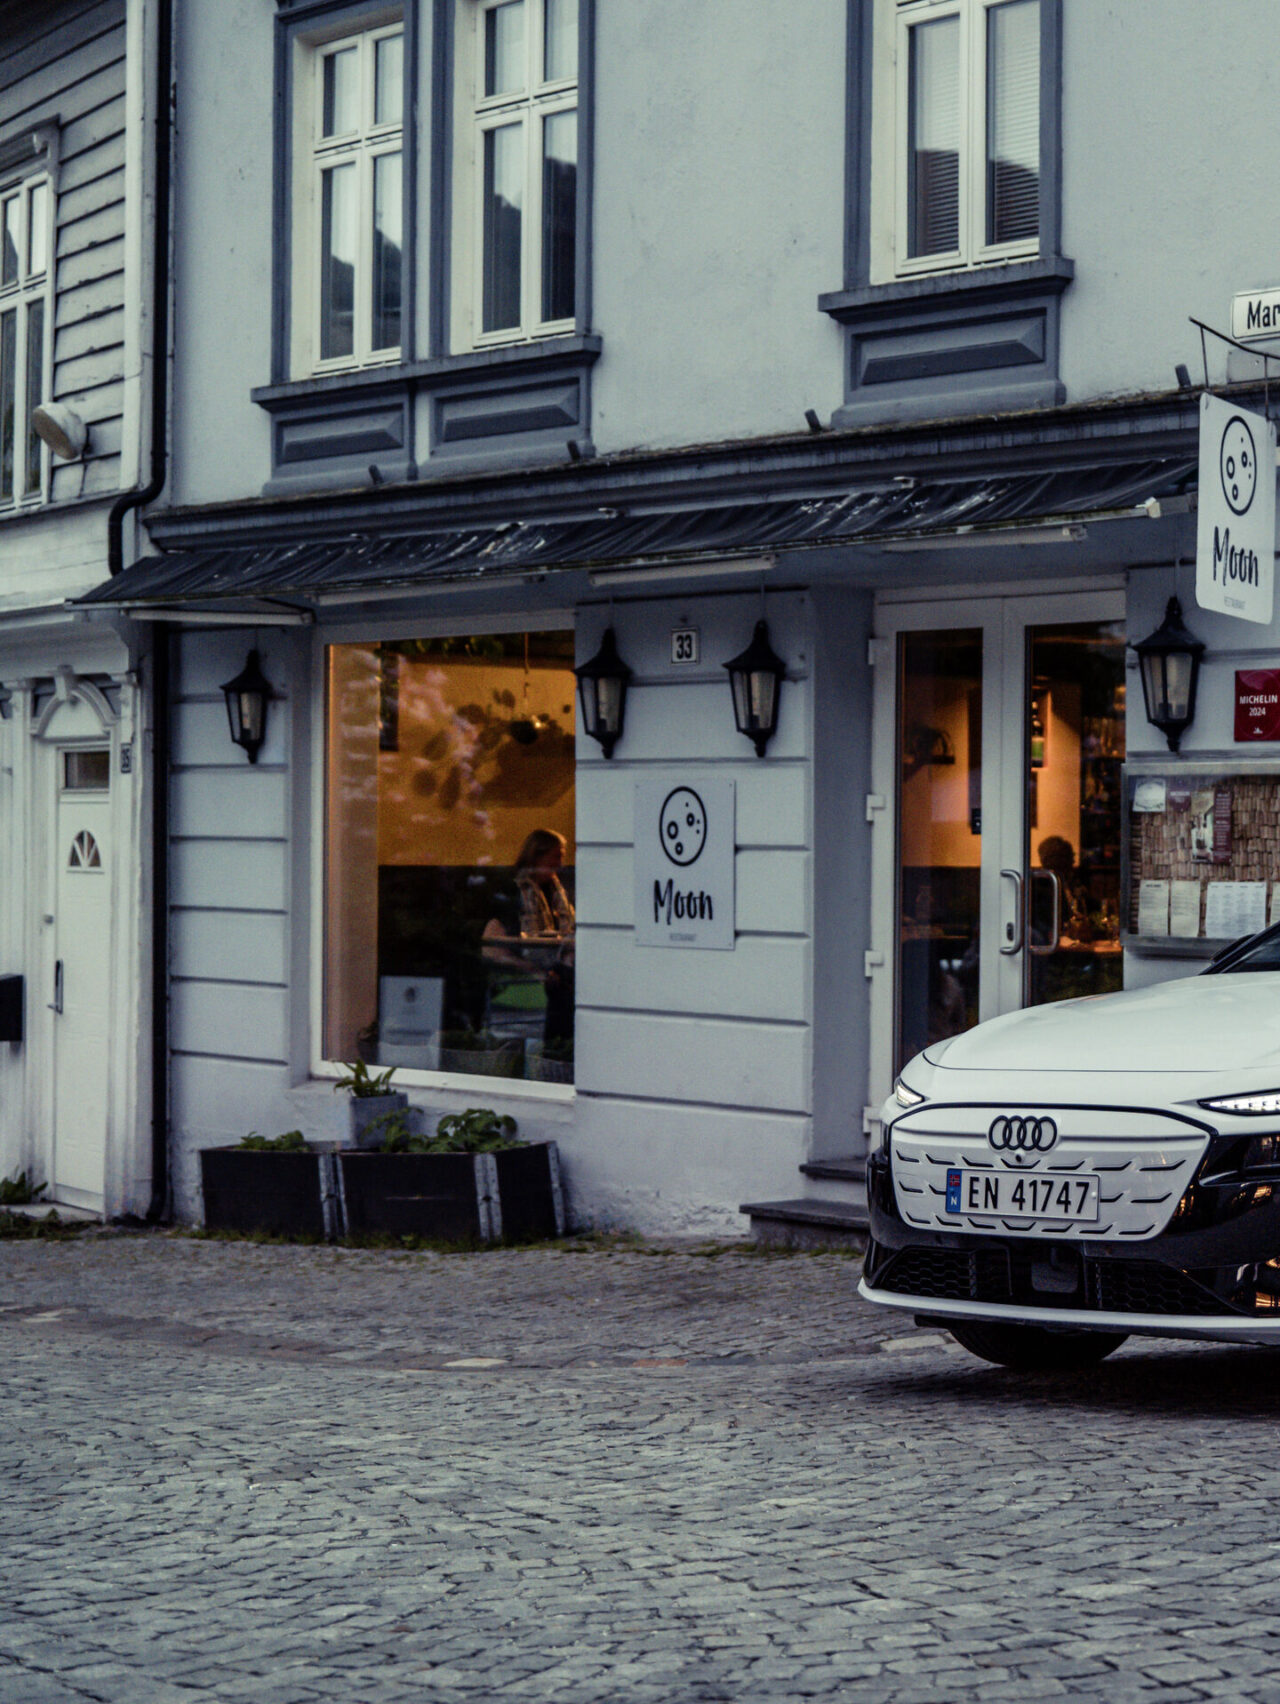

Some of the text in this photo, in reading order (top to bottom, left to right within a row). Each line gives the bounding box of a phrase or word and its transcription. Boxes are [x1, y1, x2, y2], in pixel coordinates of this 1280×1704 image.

[1213, 526, 1258, 587] Moon
[676, 634, 692, 659] 33
[1239, 695, 1278, 705] MICHELIN
[1249, 707, 1266, 716] 2024
[654, 878, 713, 925] Moon
[950, 1196, 958, 1206] N
[968, 1176, 1090, 1214] EN 41747
